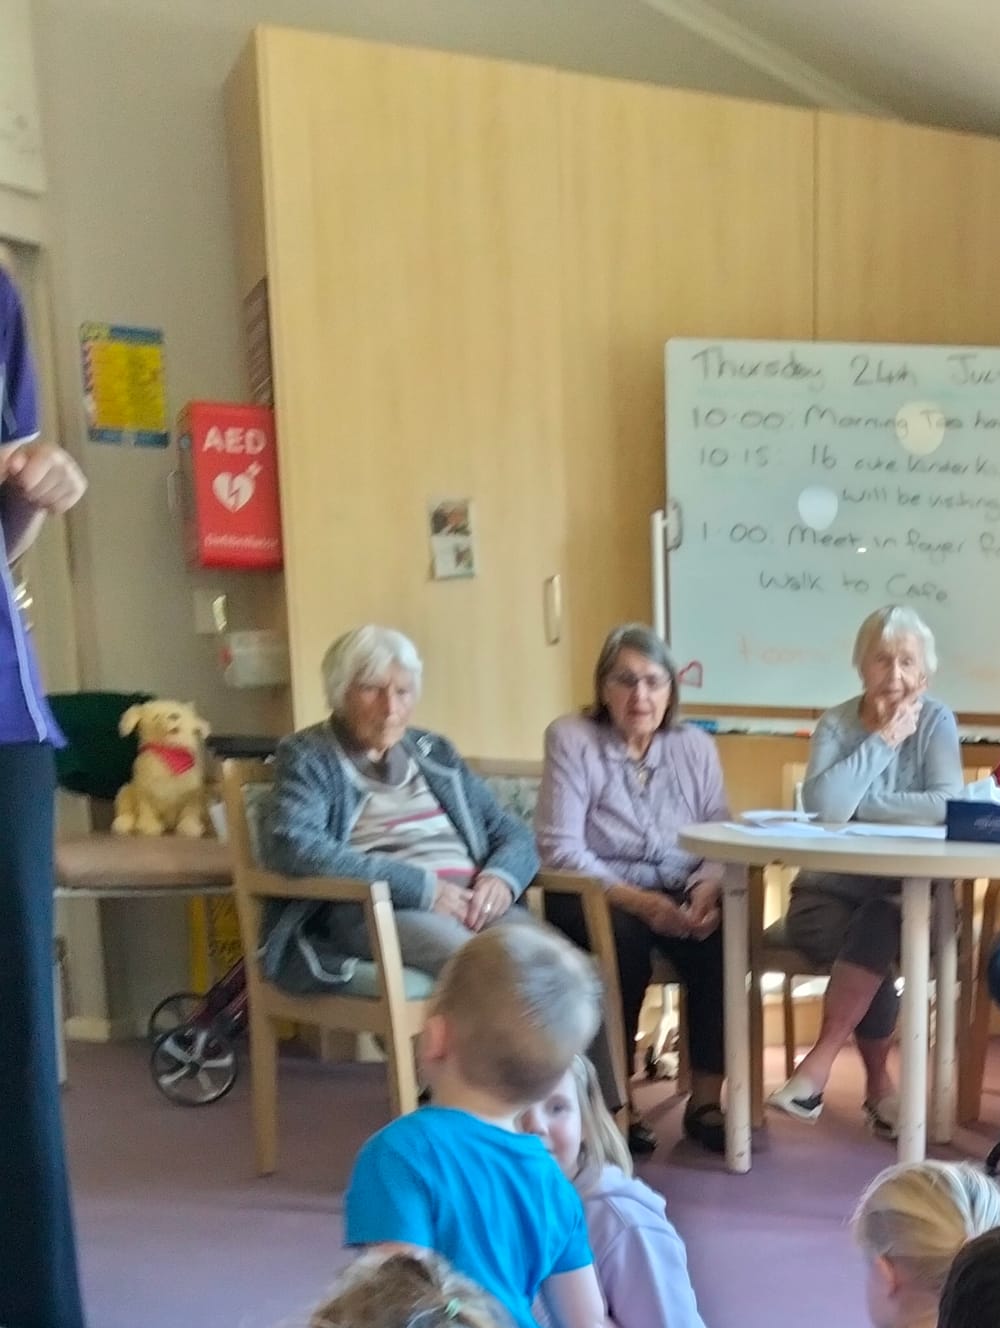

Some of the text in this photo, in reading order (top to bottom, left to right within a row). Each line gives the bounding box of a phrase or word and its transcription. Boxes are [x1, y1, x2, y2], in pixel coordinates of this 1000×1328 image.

[691, 346, 826, 392] Thursday
[803, 404, 909, 439] Morning
[203, 425, 267, 455] AED
[897, 485, 922, 507] be
[787, 524, 864, 549] Meet
[872, 535, 897, 549] in
[842, 570, 871, 594] to
